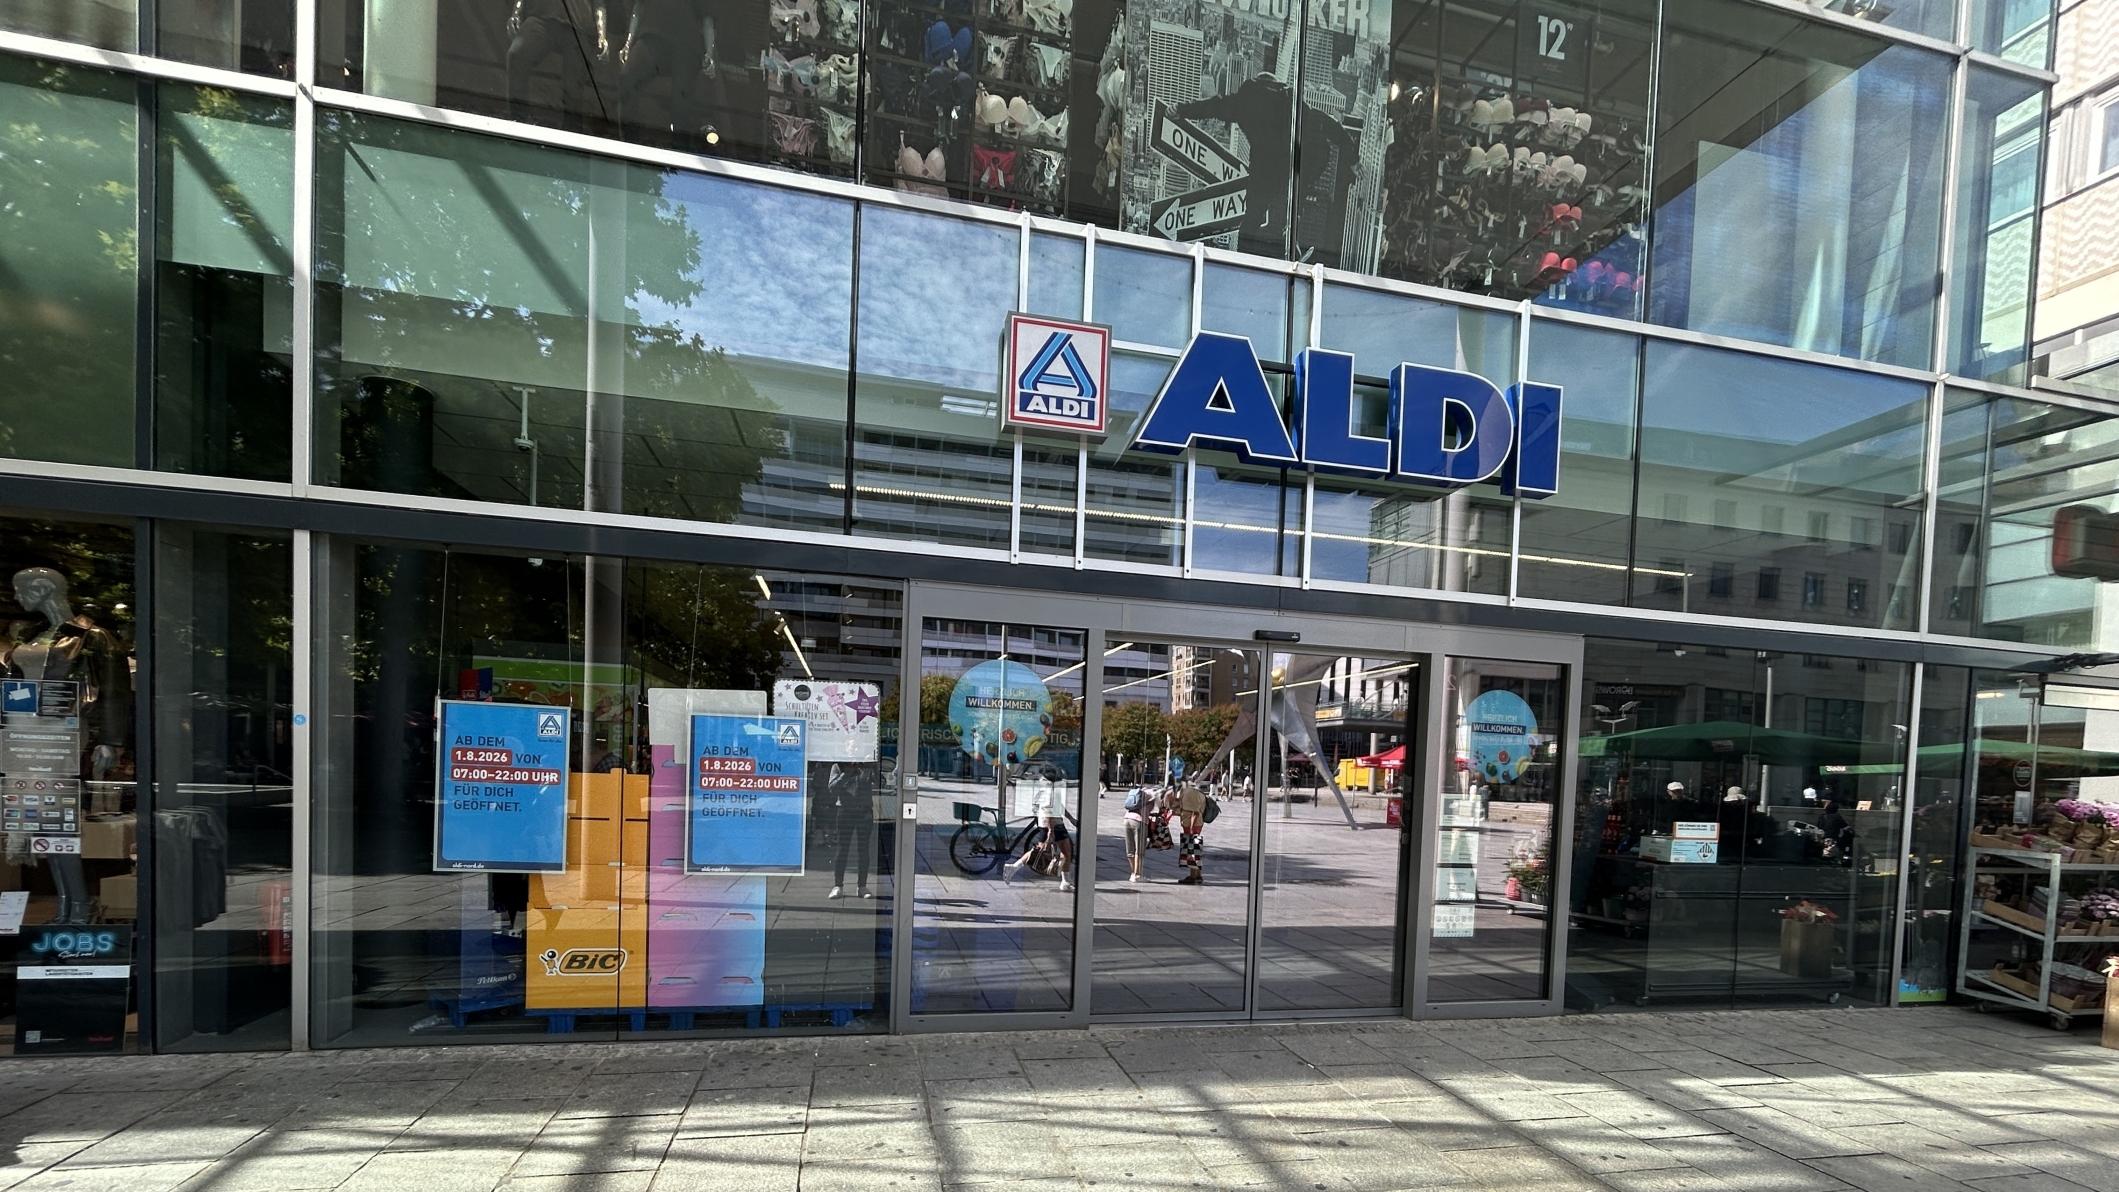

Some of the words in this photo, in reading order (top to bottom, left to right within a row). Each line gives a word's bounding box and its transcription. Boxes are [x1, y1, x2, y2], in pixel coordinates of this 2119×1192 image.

[1172, 129, 1207, 167] ONE
[1165, 206, 1196, 231] ONE
[1212, 194, 1247, 220] WAY
[1026, 395, 1088, 418] ALDI
[1133, 330, 1564, 498] ALDI
[968, 697, 1034, 710] WILLKOMMEN.
[1473, 724, 1524, 734] WILLKOMMEN.
[455, 736, 472, 745] AB
[478, 737, 505, 747] DEM
[455, 751, 508, 762] 1.8.2026
[515, 754, 541, 764] VON
[703, 746, 719, 755] AB
[724, 747, 749, 756] DEM
[704, 760, 752, 771] 1.8.2026
[758, 762, 782, 772] VON
[532, 772, 559, 782] UHR
[454, 783, 480, 796] FÜR
[484, 787, 514, 797] DICH
[773, 779, 798, 789] UHR
[702, 791, 726, 802] FÜR
[730, 794, 757, 803] DICH
[454, 799, 522, 812] GEÖFFNET.
[702, 805, 765, 817] GEÖFFNET.
[32, 932, 114, 952] JOBS
